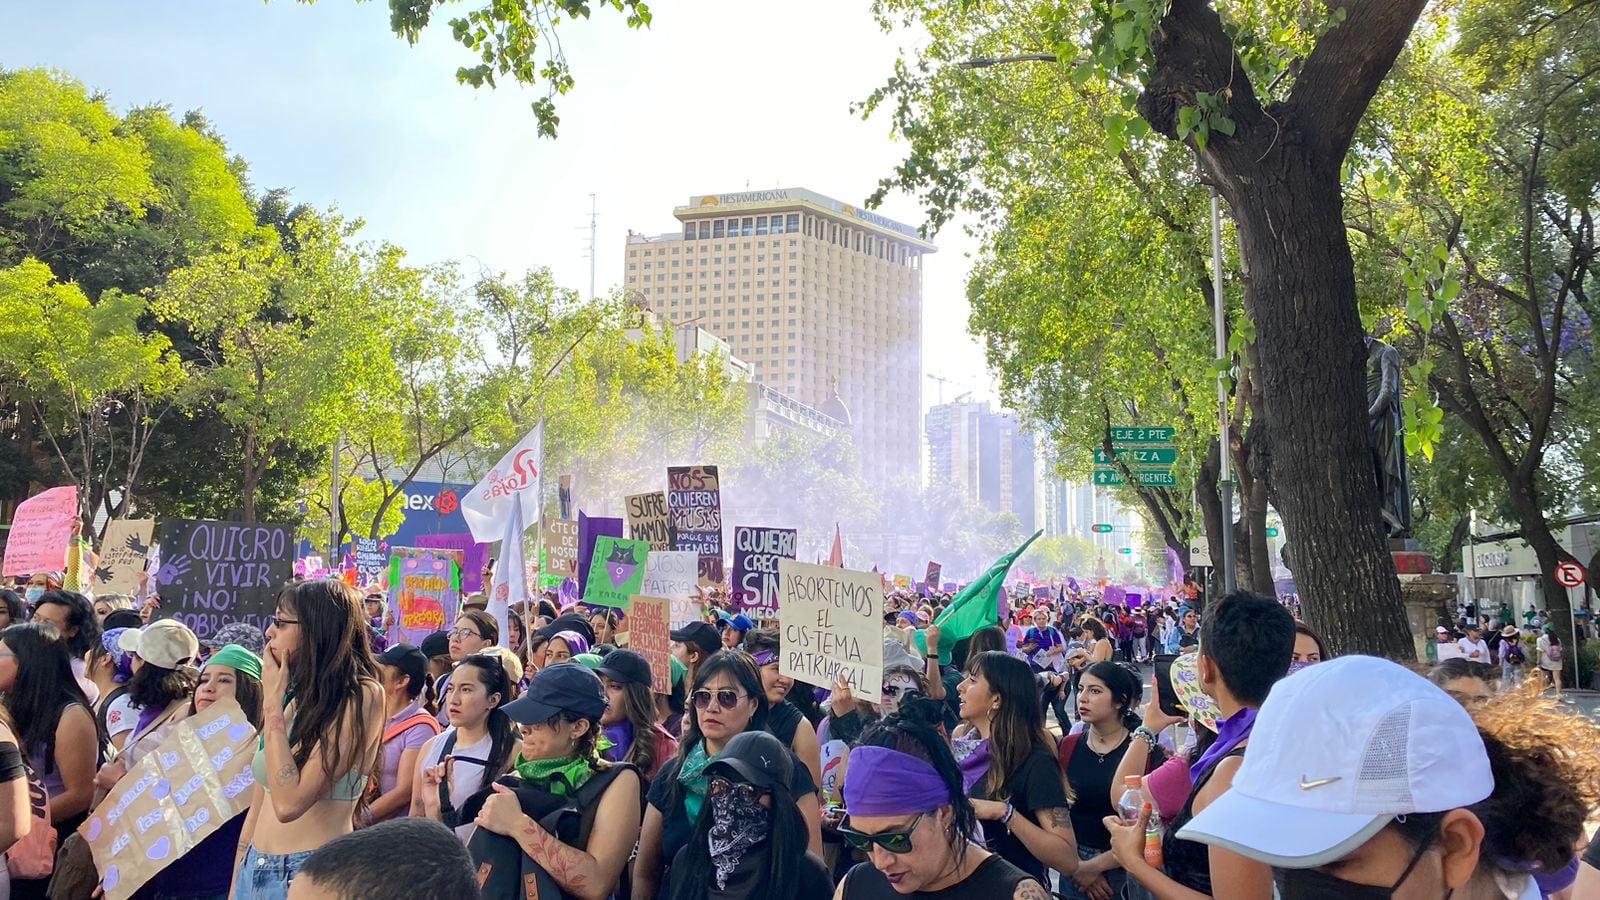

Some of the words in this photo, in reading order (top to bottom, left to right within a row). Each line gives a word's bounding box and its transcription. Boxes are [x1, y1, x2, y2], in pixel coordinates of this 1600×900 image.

[1116, 430, 1134, 440] EJE
[1138, 430, 1145, 440] 2
[1148, 430, 1167, 440] PTE
[630, 494, 668, 518] SUFRE
[668, 492, 717, 507] QUIEREN
[669, 506, 720, 530] MUSAS
[189, 524, 285, 561] QUIERO
[550, 546, 578, 558] NOSOT
[562, 538, 574, 547] DE
[676, 543, 718, 554] TEMEN
[736, 528, 796, 557] QUIERO
[205, 562, 271, 588] VIVIR
[552, 559, 566, 570] DE
[744, 554, 779, 573] CREC
[644, 579, 690, 594] PATRIA
[787, 574, 874, 617] ABORTEMOS
[817, 608, 835, 628] EL
[786, 624, 862, 662] CIS-TEMA
[789, 652, 872, 694] PATRIARCAL
[136, 808, 164, 834] las
[173, 774, 205, 806] que
[210, 746, 234, 772] ya
[184, 807, 210, 834] no
